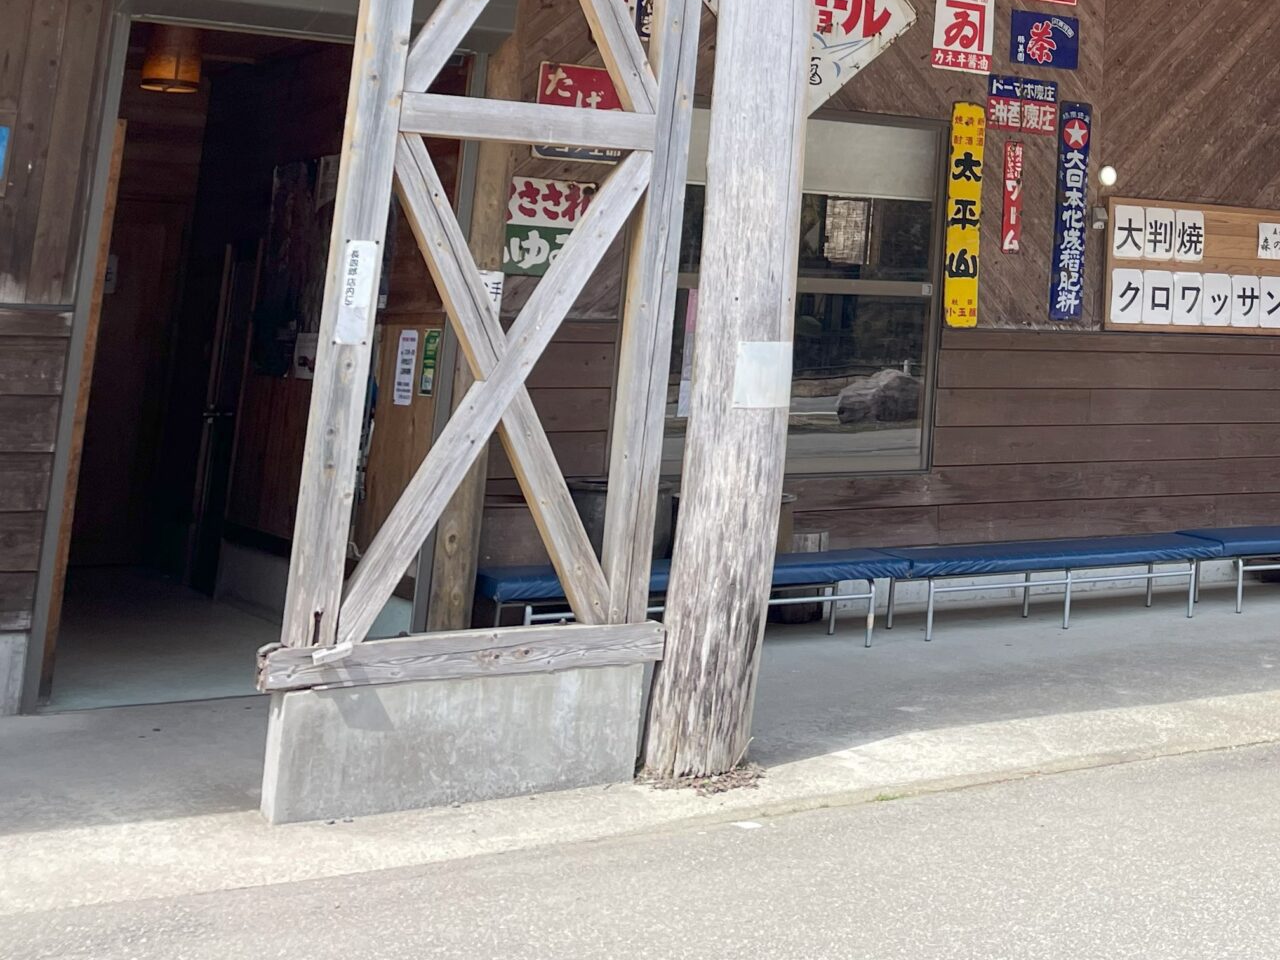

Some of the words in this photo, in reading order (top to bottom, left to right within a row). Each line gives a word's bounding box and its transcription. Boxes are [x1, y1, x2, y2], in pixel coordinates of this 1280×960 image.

[545, 67, 622, 112] たば
[945, 151, 982, 279] 太平山
[1116, 217, 1204, 256] 大判焼
